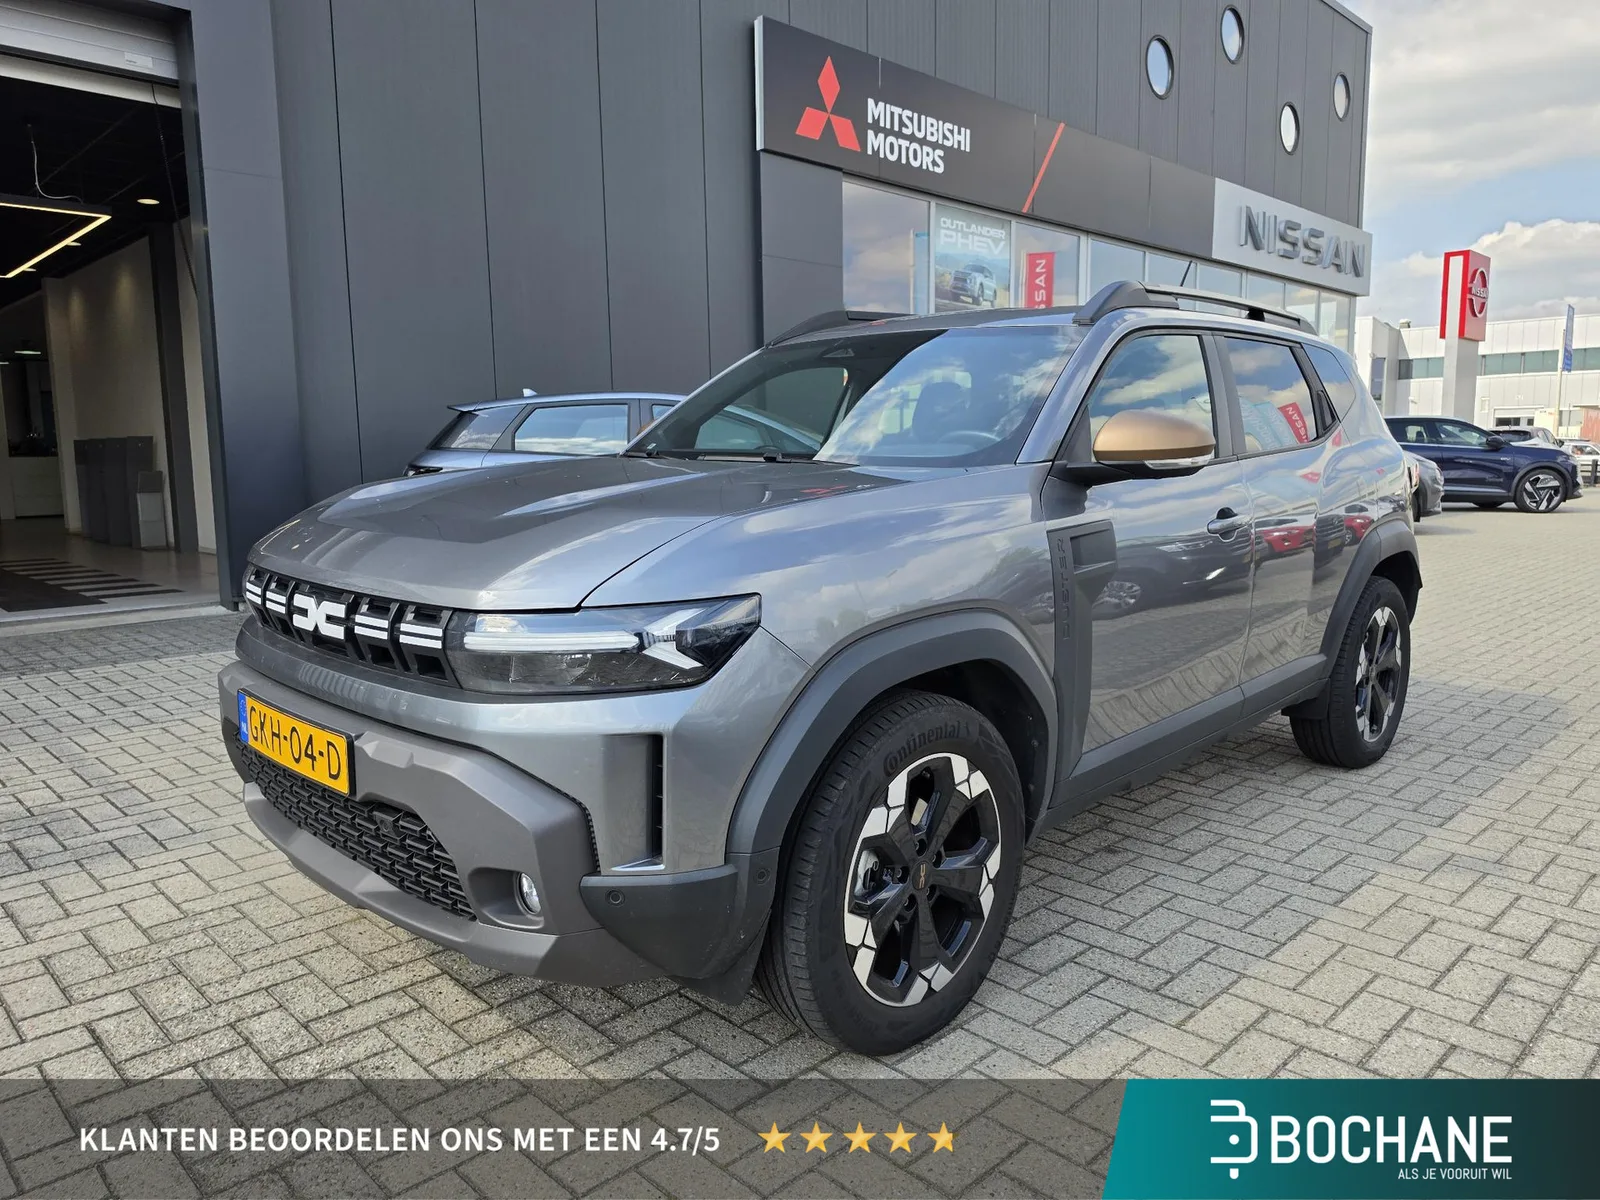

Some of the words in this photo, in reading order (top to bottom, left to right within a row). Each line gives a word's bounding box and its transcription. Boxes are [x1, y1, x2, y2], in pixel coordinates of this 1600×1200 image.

[866, 129, 945, 174] MOTORS
[867, 97, 971, 153] MITSUBISHI
[939, 216, 1006, 240] OUTLANDER
[939, 229, 1006, 256] PHEV
[1239, 204, 1366, 278] NISSAN
[1056, 538, 1070, 640] DUSTER
[241, 721, 249, 735] NL
[249, 705, 341, 781] GKH-04-D
[883, 719, 961, 777] Continental
